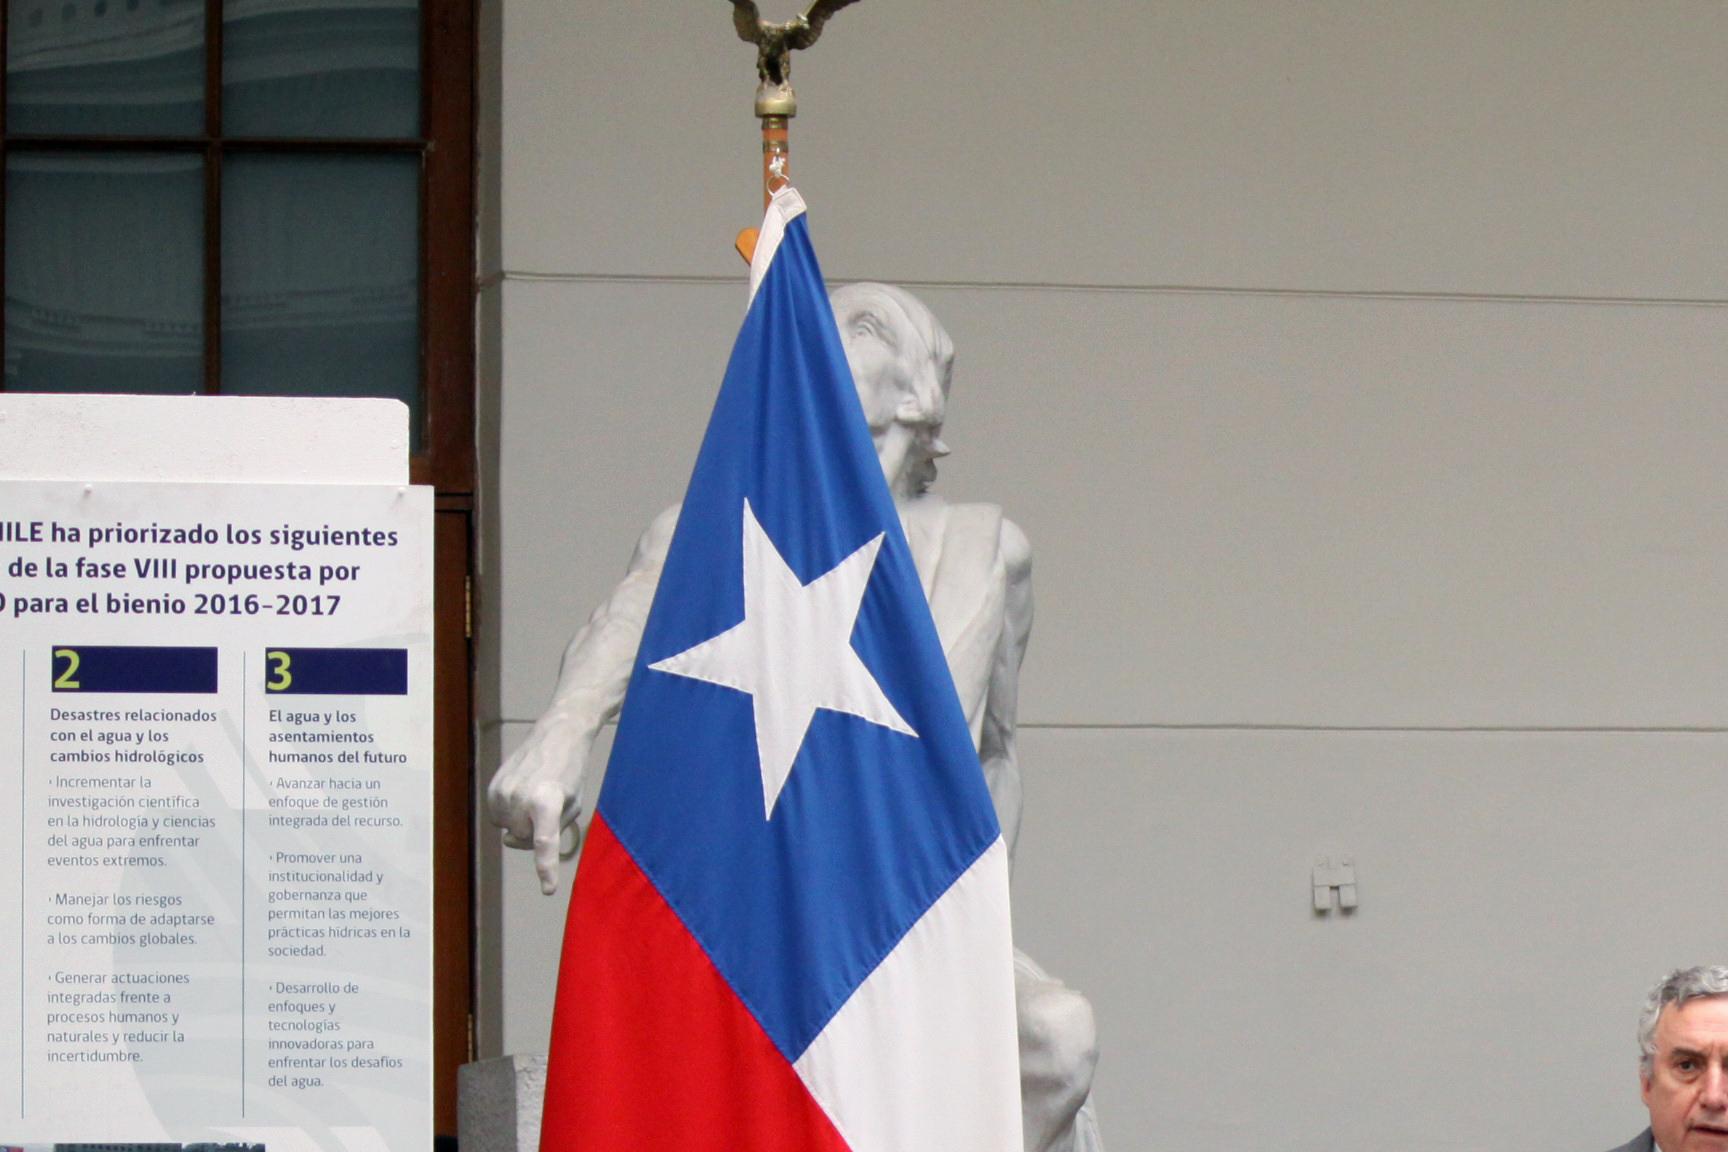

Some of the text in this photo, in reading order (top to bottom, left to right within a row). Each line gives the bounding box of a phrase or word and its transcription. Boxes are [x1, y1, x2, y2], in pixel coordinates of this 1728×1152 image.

[0, 521, 398, 550] ILE ha priorizado los siguientes
[8, 557, 360, 586] de la fase VIII propuesta por
[14, 598, 68, 618] para
[76, 593, 98, 613] el
[107, 593, 185, 614] bienio
[194, 593, 340, 615] 2016-2017
[54, 649, 81, 689] 2
[266, 652, 292, 691] 3
[51, 708, 216, 722] Desastres relacionados
[269, 709, 356, 726] El agua y los
[50, 729, 168, 745] con el agua y los
[269, 729, 374, 743] asentamientos
[50, 749, 204, 766] cambios hidrológicos
[269, 750, 407, 763] humanos del futuro
[56, 776, 151, 788] Incrementar la
[277, 778, 380, 789] Avanzar hacia un
[48, 796, 199, 810] investigación científica
[269, 797, 387, 810] enfoque de gestión
[48, 815, 215, 830] en la hidrología y ciencias
[269, 816, 402, 829] integrada del recurso.
[48, 834, 199, 849] del agua para enfrentar
[48, 855, 167, 866] eventos extremos.
[276, 852, 361, 863] Promover una
[269, 871, 383, 884] institucionalidad y
[56, 894, 182, 907] Manejar los riesgos
[269, 890, 367, 902] gobernanza que
[48, 913, 214, 927] como forma de adaptarse
[269, 908, 399, 922] permitan las mejores
[48, 933, 197, 947] a los cambios globales.
[269, 926, 410, 940] prácticas hídricas en la
[268, 945, 325, 956] sociedad.
[55, 972, 189, 984] Generar actuaciones
[276, 982, 359, 993] Desarrollo de
[48, 991, 170, 1005] integradas frente a
[268, 1001, 335, 1015] enfoques y
[48, 1011, 179, 1025] procesos humanos y
[269, 1020, 340, 1033] tecnologías
[48, 1030, 184, 1045] naturales y reducir la
[269, 1038, 374, 1051] innovadoras para
[48, 1050, 143, 1062] incertidumbre.
[268, 1056, 402, 1068] enfrentar los desafíos
[269, 1076, 324, 1089] del agua.
